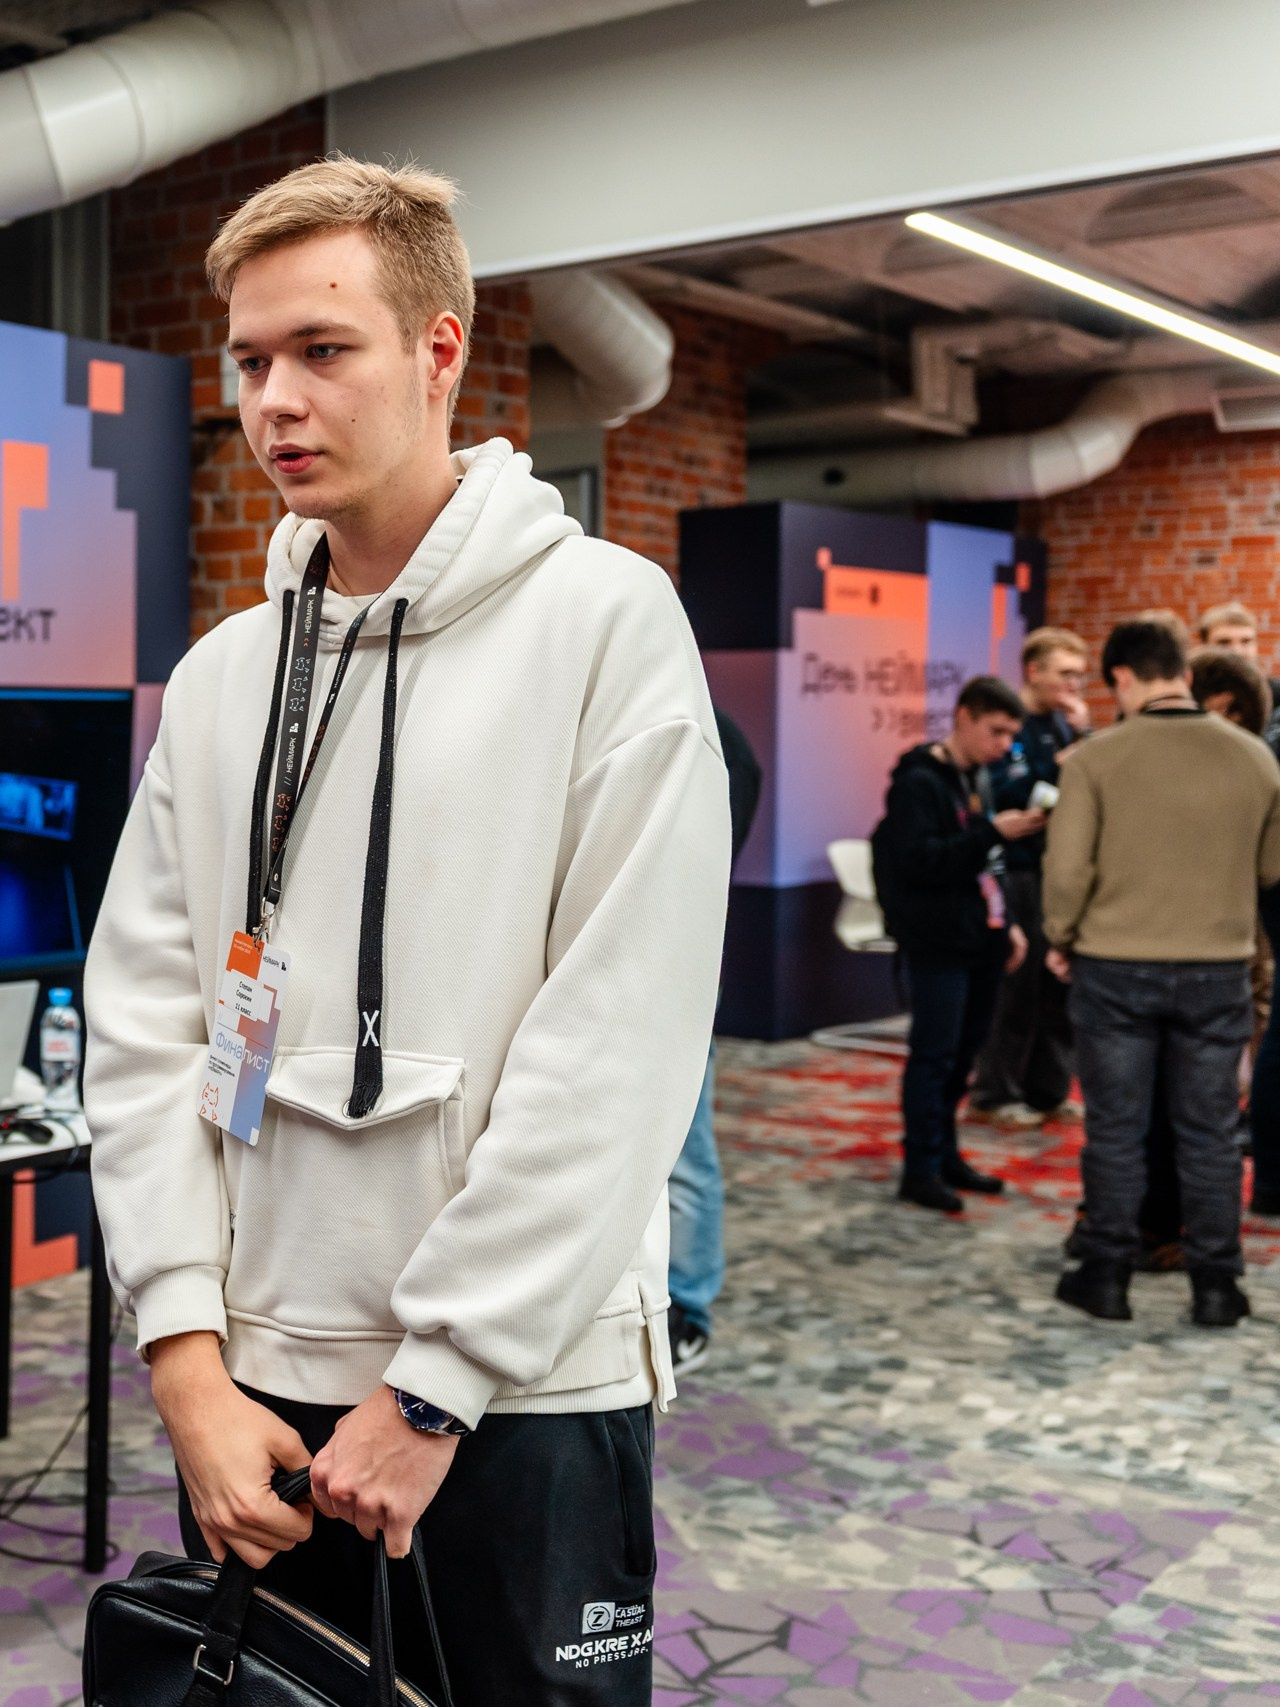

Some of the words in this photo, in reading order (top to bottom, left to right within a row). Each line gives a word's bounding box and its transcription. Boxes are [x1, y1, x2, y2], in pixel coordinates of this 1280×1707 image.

[304, 599, 315, 634] НЕЙМАРК
[286, 737, 297, 774] НЕЙМАРК
[240, 1006, 252, 1017] класс
[362, 1009, 380, 1047] X
[215, 1032, 270, 1073] Финалист
[615, 1604, 646, 1619] CASUAL
[575, 1659, 590, 1669] NO
